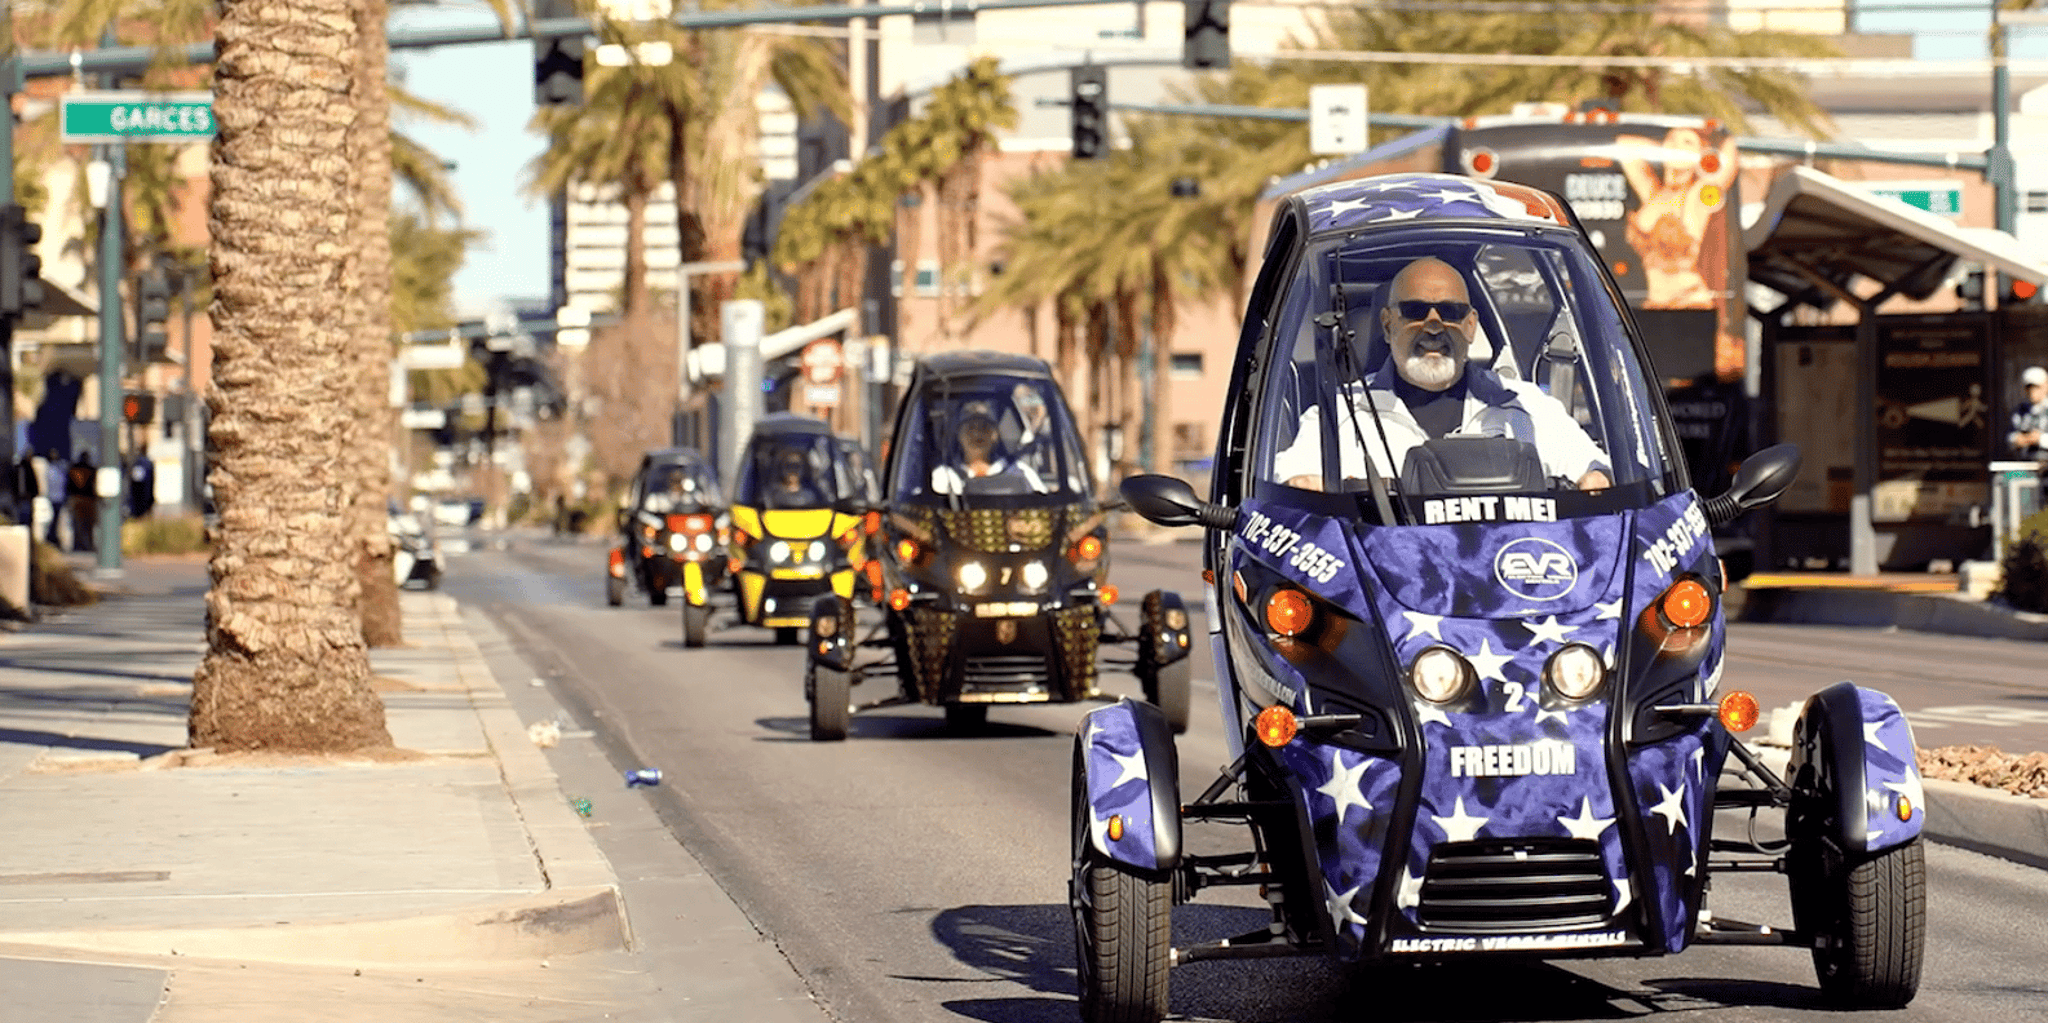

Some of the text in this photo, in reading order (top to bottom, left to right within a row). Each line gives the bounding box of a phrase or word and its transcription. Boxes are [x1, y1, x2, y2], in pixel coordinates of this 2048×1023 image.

[110, 106, 211, 131] GARCES
[1424, 496, 1499, 525] RENT
[1241, 510, 1346, 584] 702-337-3555
[1000, 566, 1013, 585] 7
[1500, 552, 1573, 579] EVR
[1502, 681, 1525, 713] 2
[1450, 744, 1576, 778] FREEDOM
[1392, 938, 1476, 953] ELECTRIC
